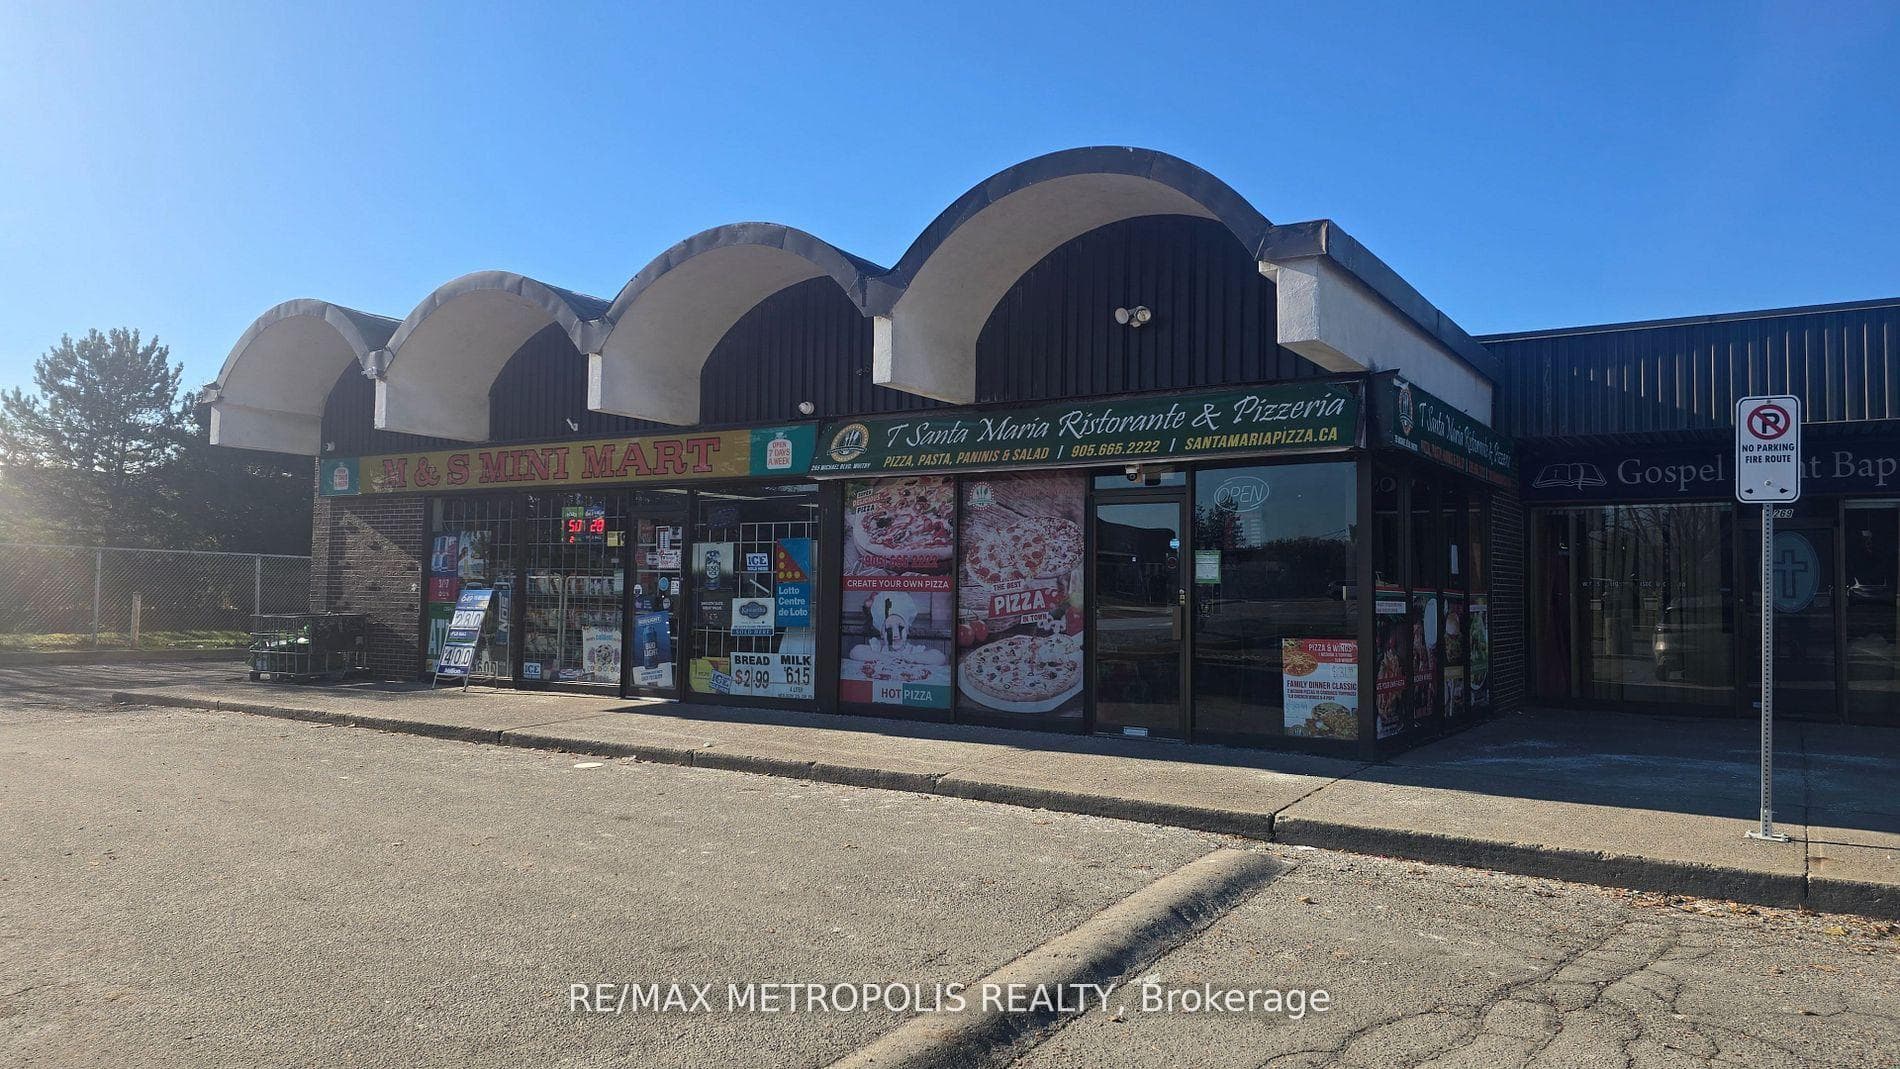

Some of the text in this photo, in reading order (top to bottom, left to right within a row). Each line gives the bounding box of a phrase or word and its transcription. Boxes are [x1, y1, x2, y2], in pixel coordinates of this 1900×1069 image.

[887, 423, 910, 448] T
[906, 421, 969, 446] Santa
[1059, 403, 1186, 440] Ristorante
[1192, 403, 1221, 431] &
[1233, 392, 1346, 424] Pizzeria
[883, 427, 1337, 468] PIZZA, PASTA, PANINIS & SALAD 905.665.2222 SANTAMARIAPIZZA.CA
[1742, 443, 1795, 453] NO PARKING
[383, 458, 407, 488] M
[414, 456, 440, 487] &
[447, 453, 469, 486] S
[479, 447, 569, 484] MINI
[582, 437, 720, 479] MART
[774, 457, 790, 465] WEEK
[1745, 455, 1791, 463] FIRE ROUTE
[1617, 455, 1725, 491] Gospel
[1217, 485, 1263, 503] OPEN
[1773, 508, 1793, 518] 269
[748, 555, 767, 566] ICE
[847, 580, 949, 589] CREATE YOUR OWN PIZZA
[1007, 581, 1022, 589] BEST
[779, 586, 800, 595] Lotto
[778, 597, 806, 606] Centre
[994, 590, 1046, 615] PIZZA
[778, 608, 808, 617] de Loto
[1030, 614, 1048, 622] TOWN
[1308, 643, 1326, 652] PIZZA
[734, 655, 811, 666] BREAD MILK
[524, 663, 540, 673] ICE
[712, 672, 731, 687] ICE
[735, 669, 770, 689] $2.99
[1287, 680, 1357, 691] FAMILY DINNER CLASSIC
[881, 688, 933, 701] HOT PIZZA
